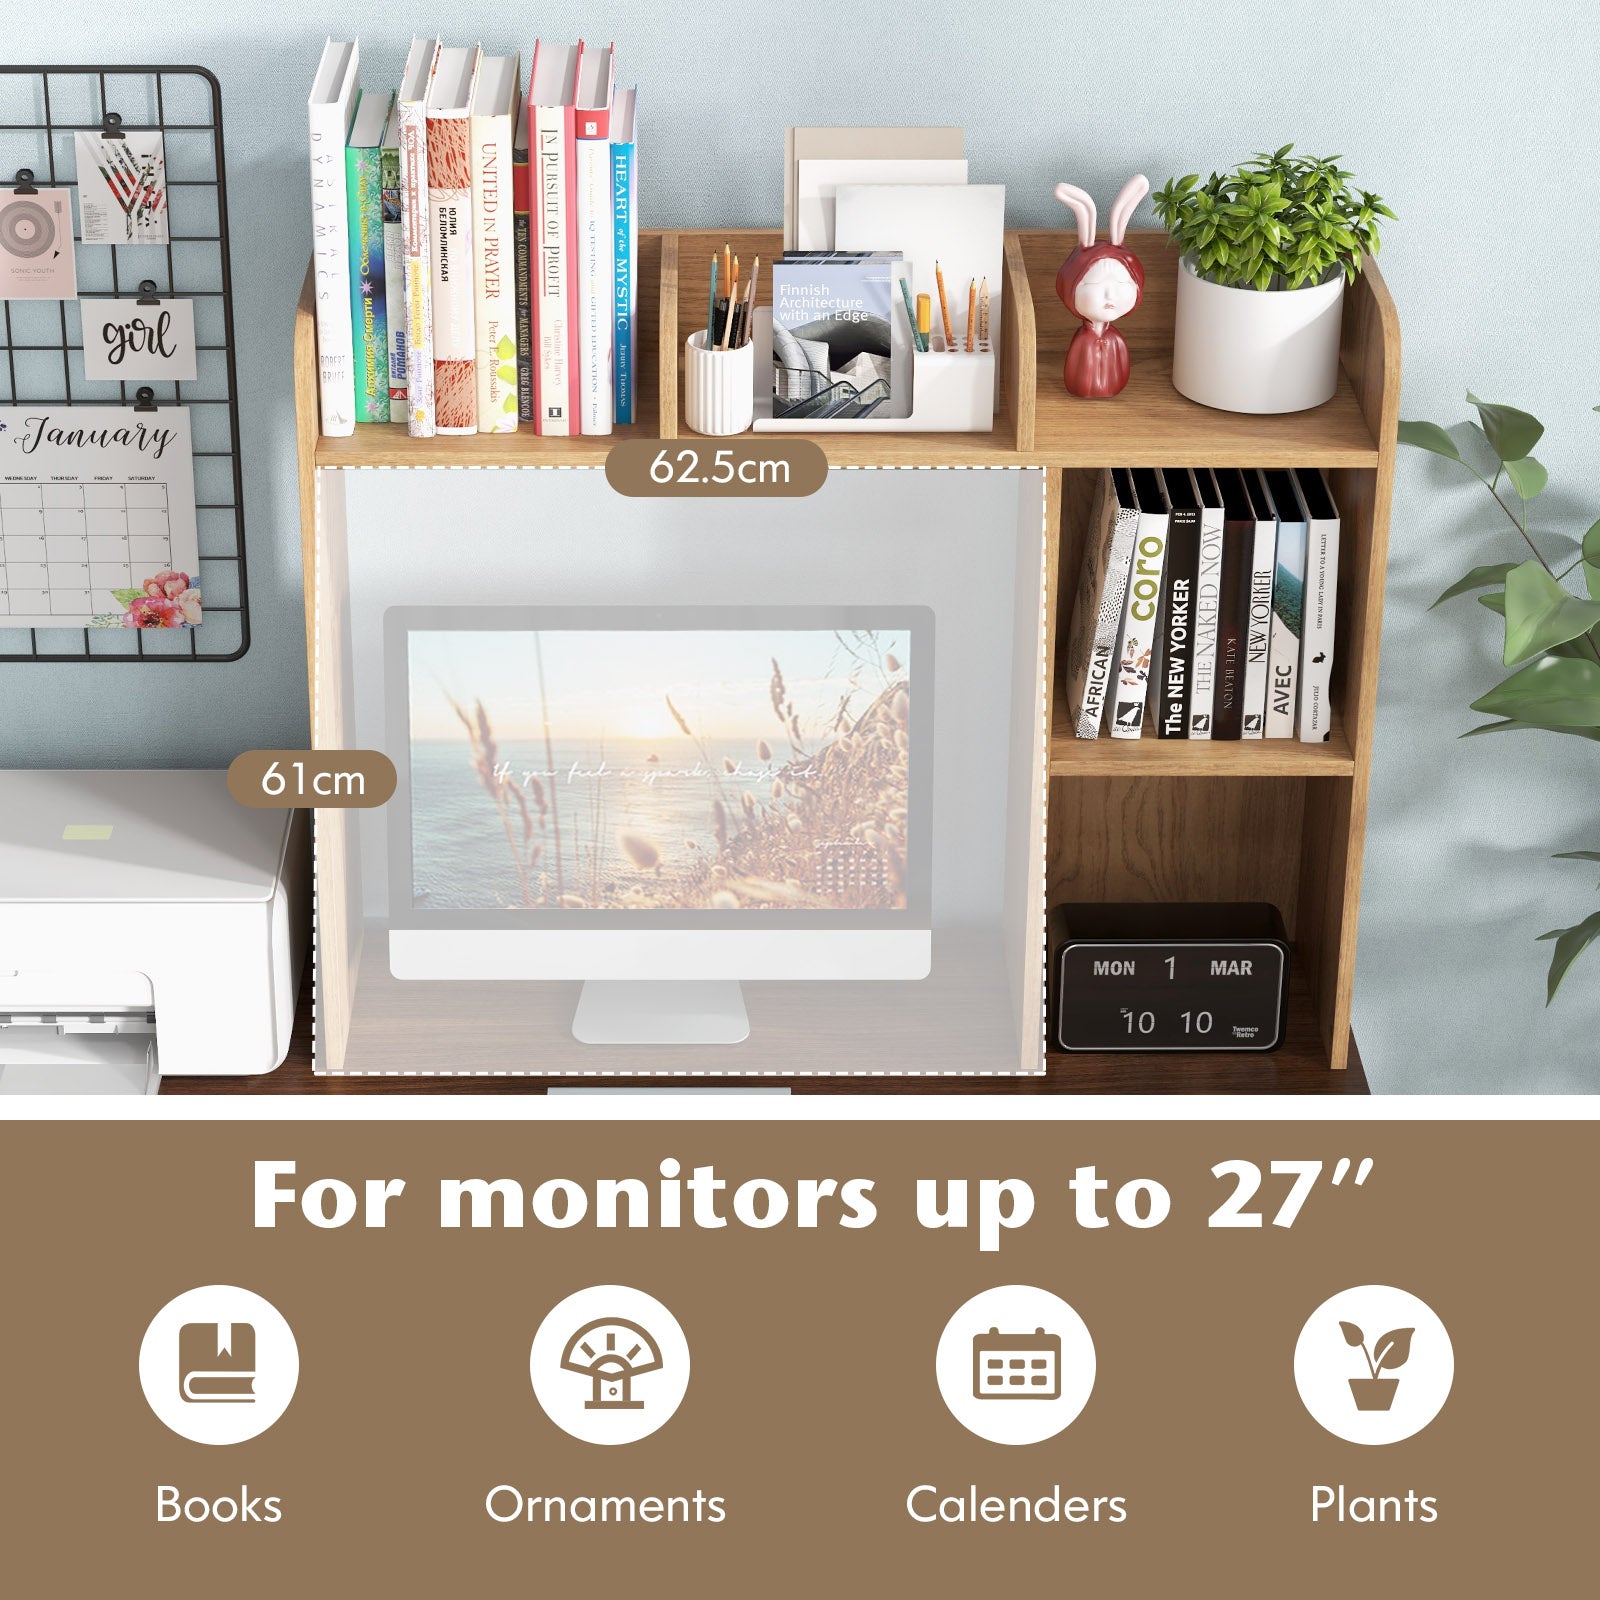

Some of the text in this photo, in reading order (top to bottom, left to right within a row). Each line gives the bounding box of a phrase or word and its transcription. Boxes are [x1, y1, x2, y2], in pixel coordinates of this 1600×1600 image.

[311, 133, 329, 300] DYNAMICS
[449, 206, 458, 236] ЮЛИЯ
[481, 142, 500, 300] UNITED IN PRAYER
[518, 228, 527, 242] TEN
[541, 129, 560, 298] IN PURSUIT OF PROFIT
[588, 220, 596, 232] IQ
[439, 206, 450, 283] БЕЛОМЛИНСКАЯ
[588, 234, 597, 277] TESTING
[615, 155, 628, 330] HEART of the MYSTIC
[518, 244, 529, 306] COMMANDMENTS
[780, 284, 830, 296] Finnish
[590, 296, 598, 333] GIFTED
[780, 297, 863, 309] Architecture
[780, 309, 868, 323] with an Edge
[102, 311, 177, 365] girl
[362, 297, 376, 396] Алхимия Смерти
[487, 320, 499, 343] Peter
[519, 318, 529, 357] MANAGERS
[542, 336, 552, 370] Bill Sykes
[552, 319, 563, 386] Christine Harvey
[395, 331, 406, 380] РОМАНОВ
[489, 359, 501, 404] Roussakis
[520, 367, 530, 418] GREG BLENCOE
[14, 416, 178, 459] January
[1130, 536, 1164, 622] coro
[1319, 556, 1326, 565] TO
[1195, 523, 1221, 694] THE NAKED NOW
[1164, 578, 1190, 736] The NEW YORKER
[1223, 638, 1237, 709] KATE BEATON
[1085, 645, 1110, 718] AFRICAN
[1273, 665, 1292, 715] AVEC
[493, 761, 513, 784] If
[522, 769, 559, 787] you
[1093, 956, 1253, 980] MON 1 MAR
[1123, 1011, 1213, 1034] 10 10
